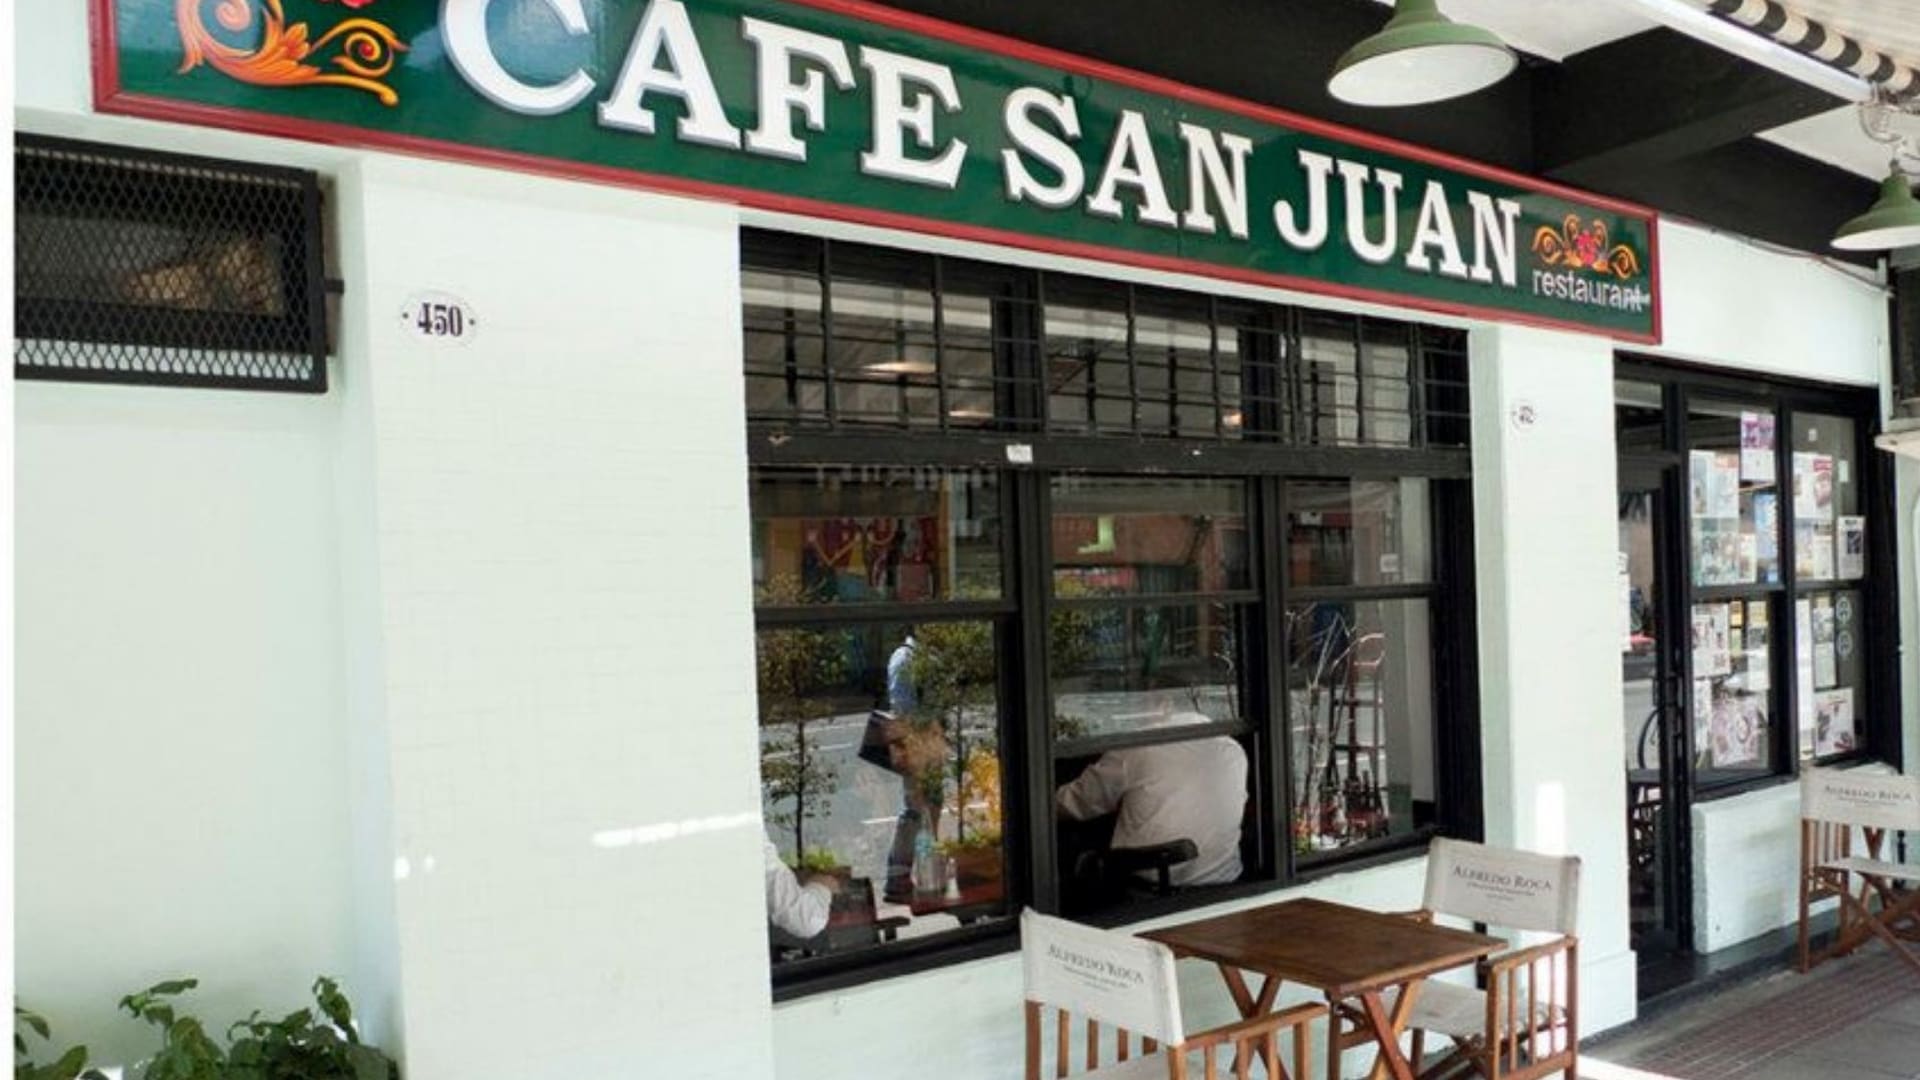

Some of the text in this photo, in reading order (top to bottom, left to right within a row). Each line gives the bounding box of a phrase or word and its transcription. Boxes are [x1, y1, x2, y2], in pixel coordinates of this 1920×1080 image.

[439, 0, 1522, 287] CAFE SAN JUAN
[1531, 268, 1643, 312] restaurant
[417, 301, 464, 337] 450
[1514, 874, 1552, 891] ROCA
[1106, 961, 1145, 985] ROCA
